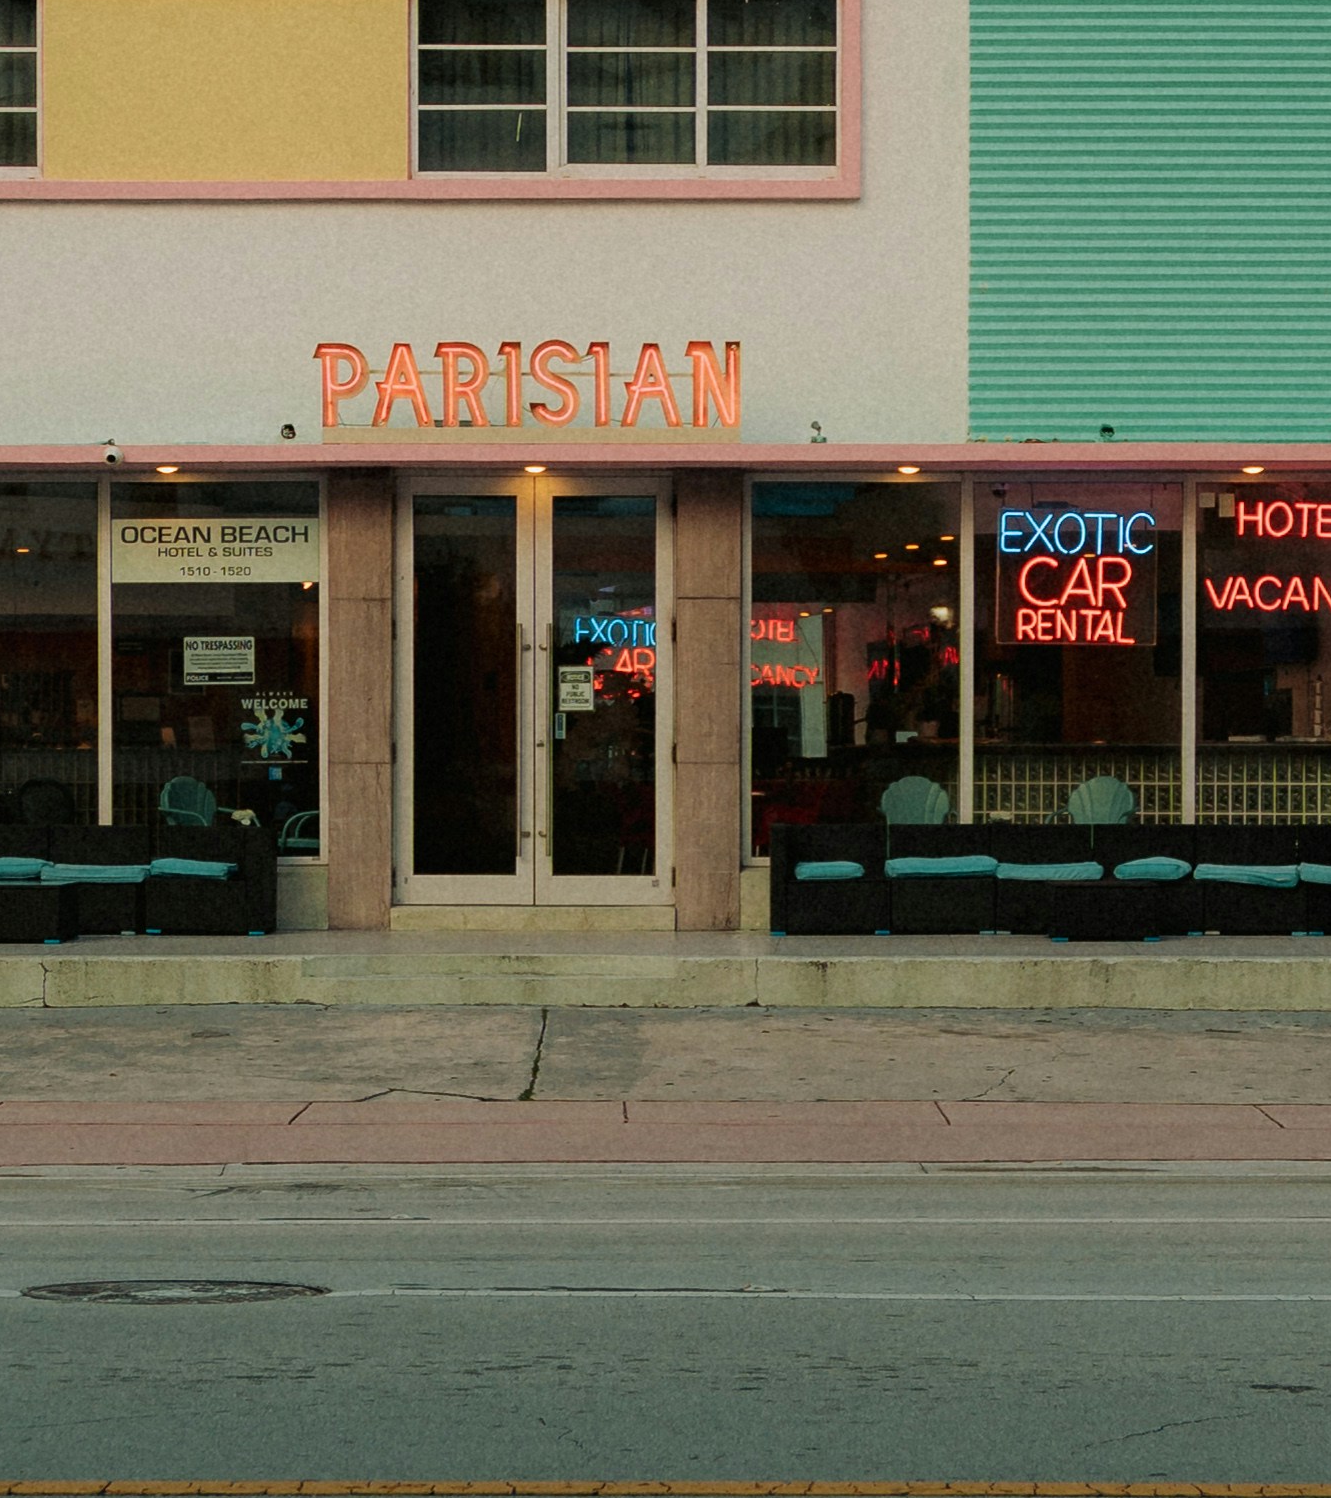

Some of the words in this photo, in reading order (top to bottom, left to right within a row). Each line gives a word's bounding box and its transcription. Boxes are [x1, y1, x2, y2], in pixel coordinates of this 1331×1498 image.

[312, 339, 741, 427] PARISIAN
[120, 525, 211, 544] OCEAN
[220, 525, 309, 544] BEACH
[1000, 511, 1156, 555] EXOTIC
[157, 546, 203, 557] HOTEL
[208, 546, 217, 557] &
[222, 546, 273, 557] SUITES
[180, 566, 210, 576] 1510
[221, 566, 251, 576] 1520
[1019, 555, 1133, 608] CAR
[1016, 608, 1136, 644] RENTAL
[185, 640, 199, 651] NO
[200, 640, 253, 651] TRESPASSING
[241, 698, 308, 710] WELCOME
